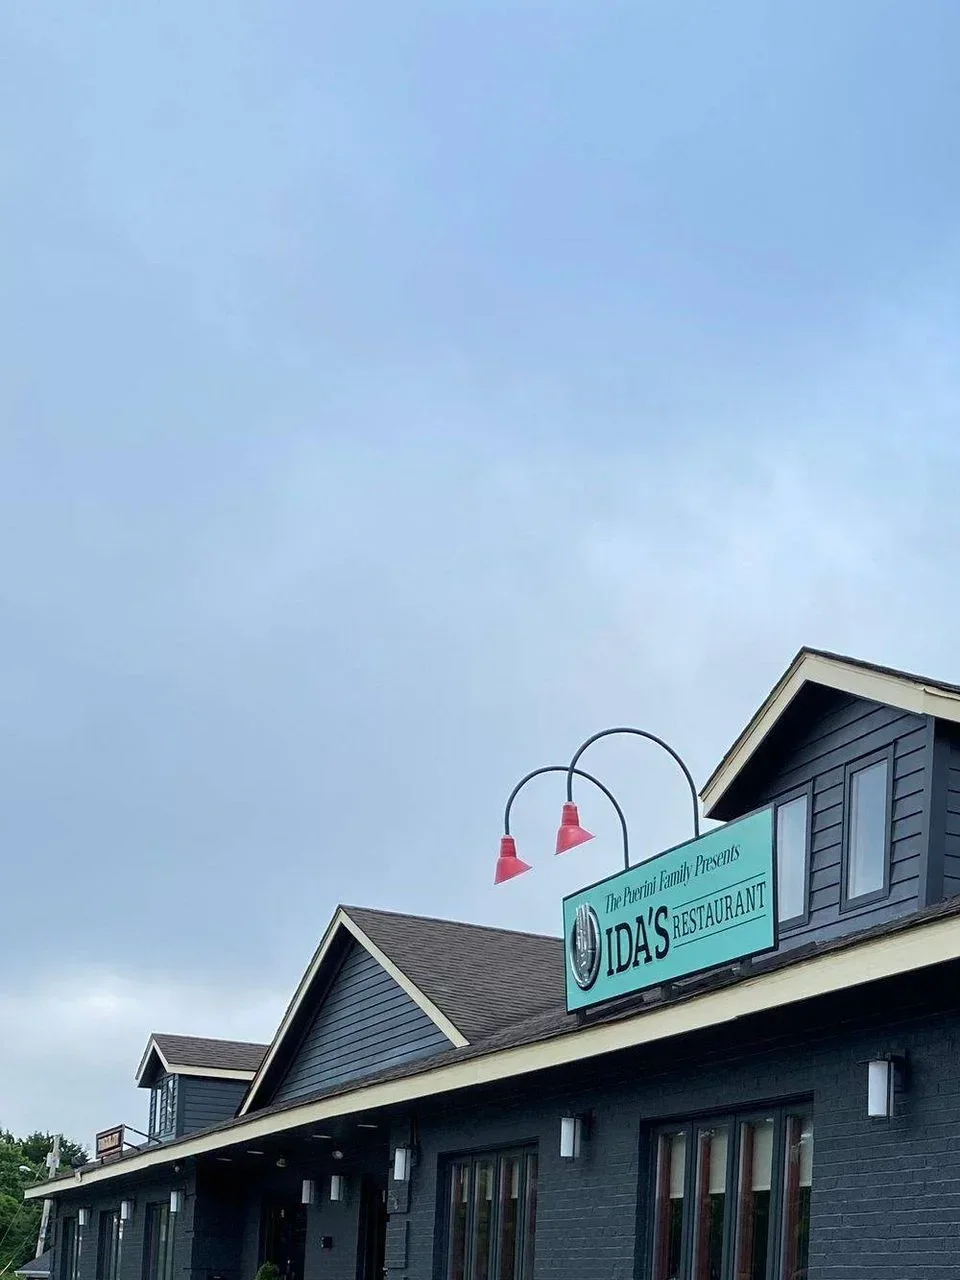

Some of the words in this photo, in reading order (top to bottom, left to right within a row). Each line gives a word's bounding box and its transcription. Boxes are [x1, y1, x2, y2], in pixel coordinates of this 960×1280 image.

[605, 894, 622, 914] The
[623, 877, 657, 906] Puerini
[659, 862, 693, 892] Family
[695, 844, 741, 877] Presents
[606, 906, 670, 976] IDA'S
[672, 881, 767, 940] RESTAURANT
